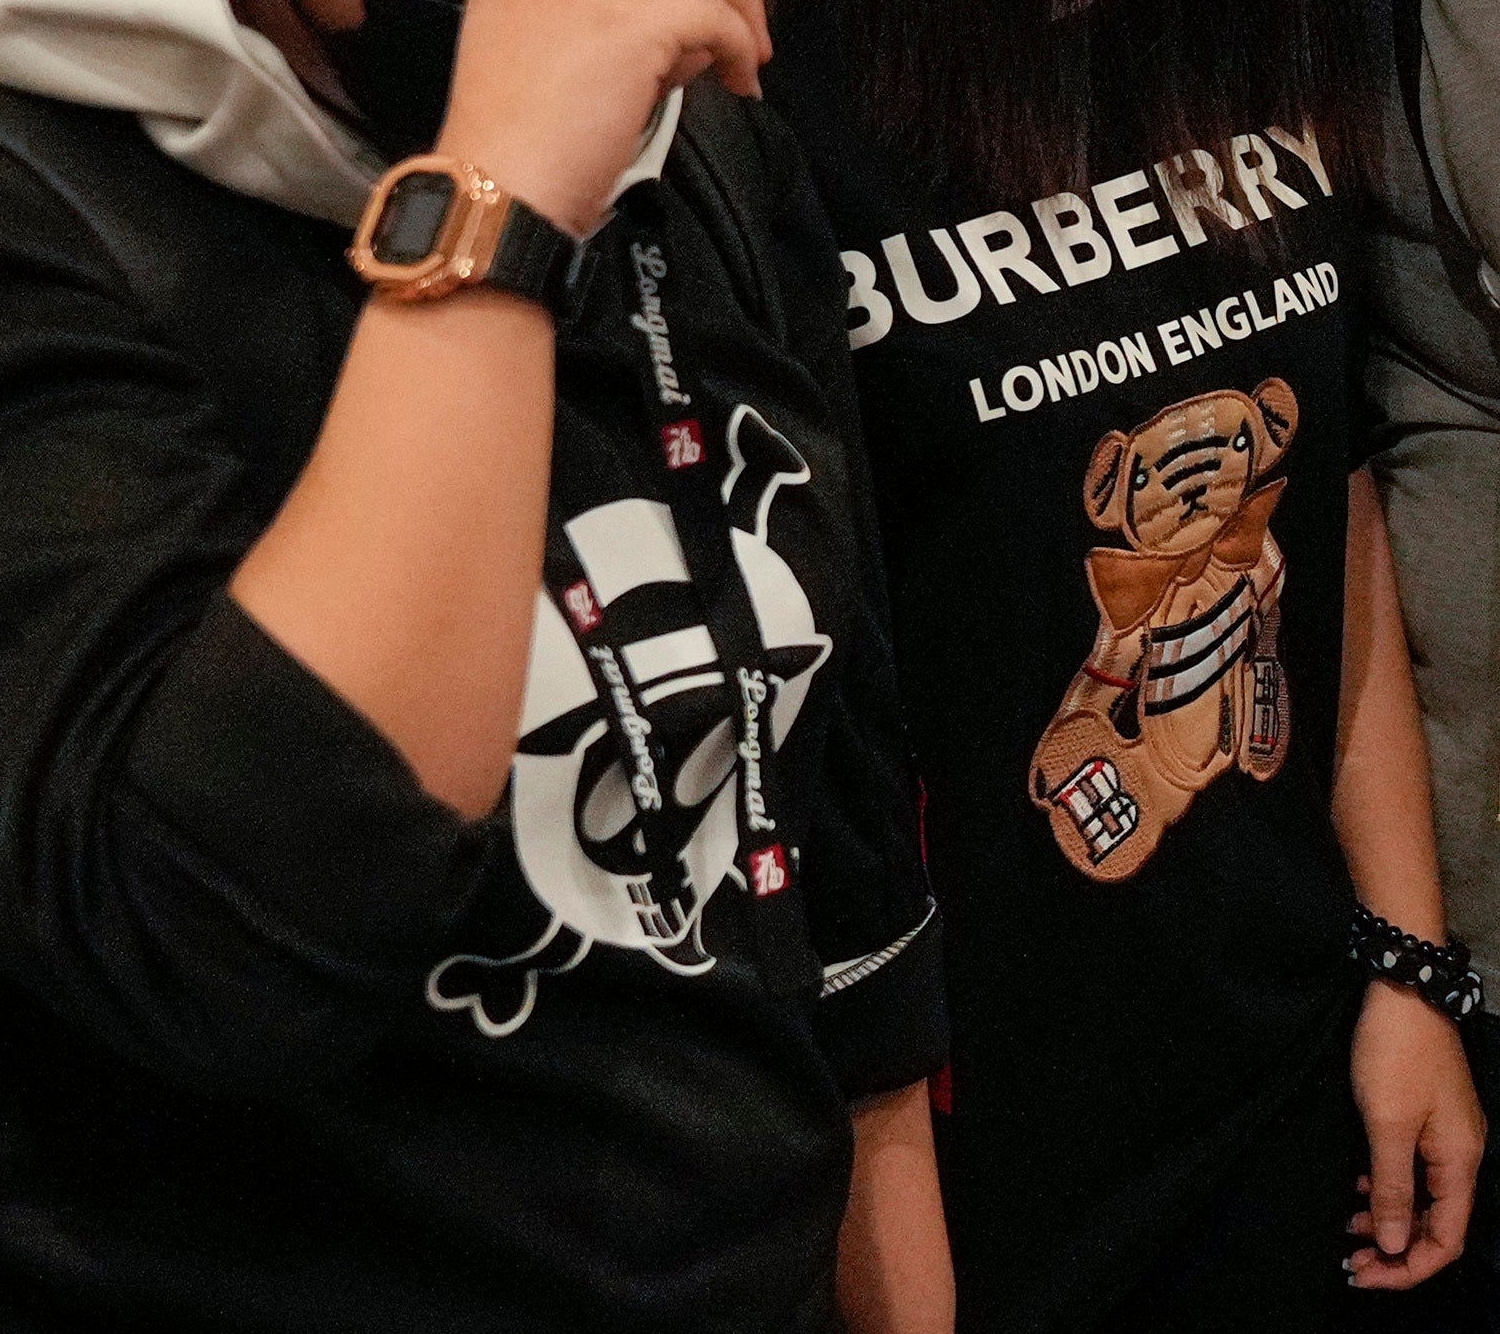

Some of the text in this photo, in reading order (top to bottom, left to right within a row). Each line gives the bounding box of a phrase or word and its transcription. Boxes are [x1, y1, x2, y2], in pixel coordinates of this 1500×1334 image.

[839, 124, 1334, 351] BURBERRY
[970, 261, 1340, 423] LONDON ENGLAND
